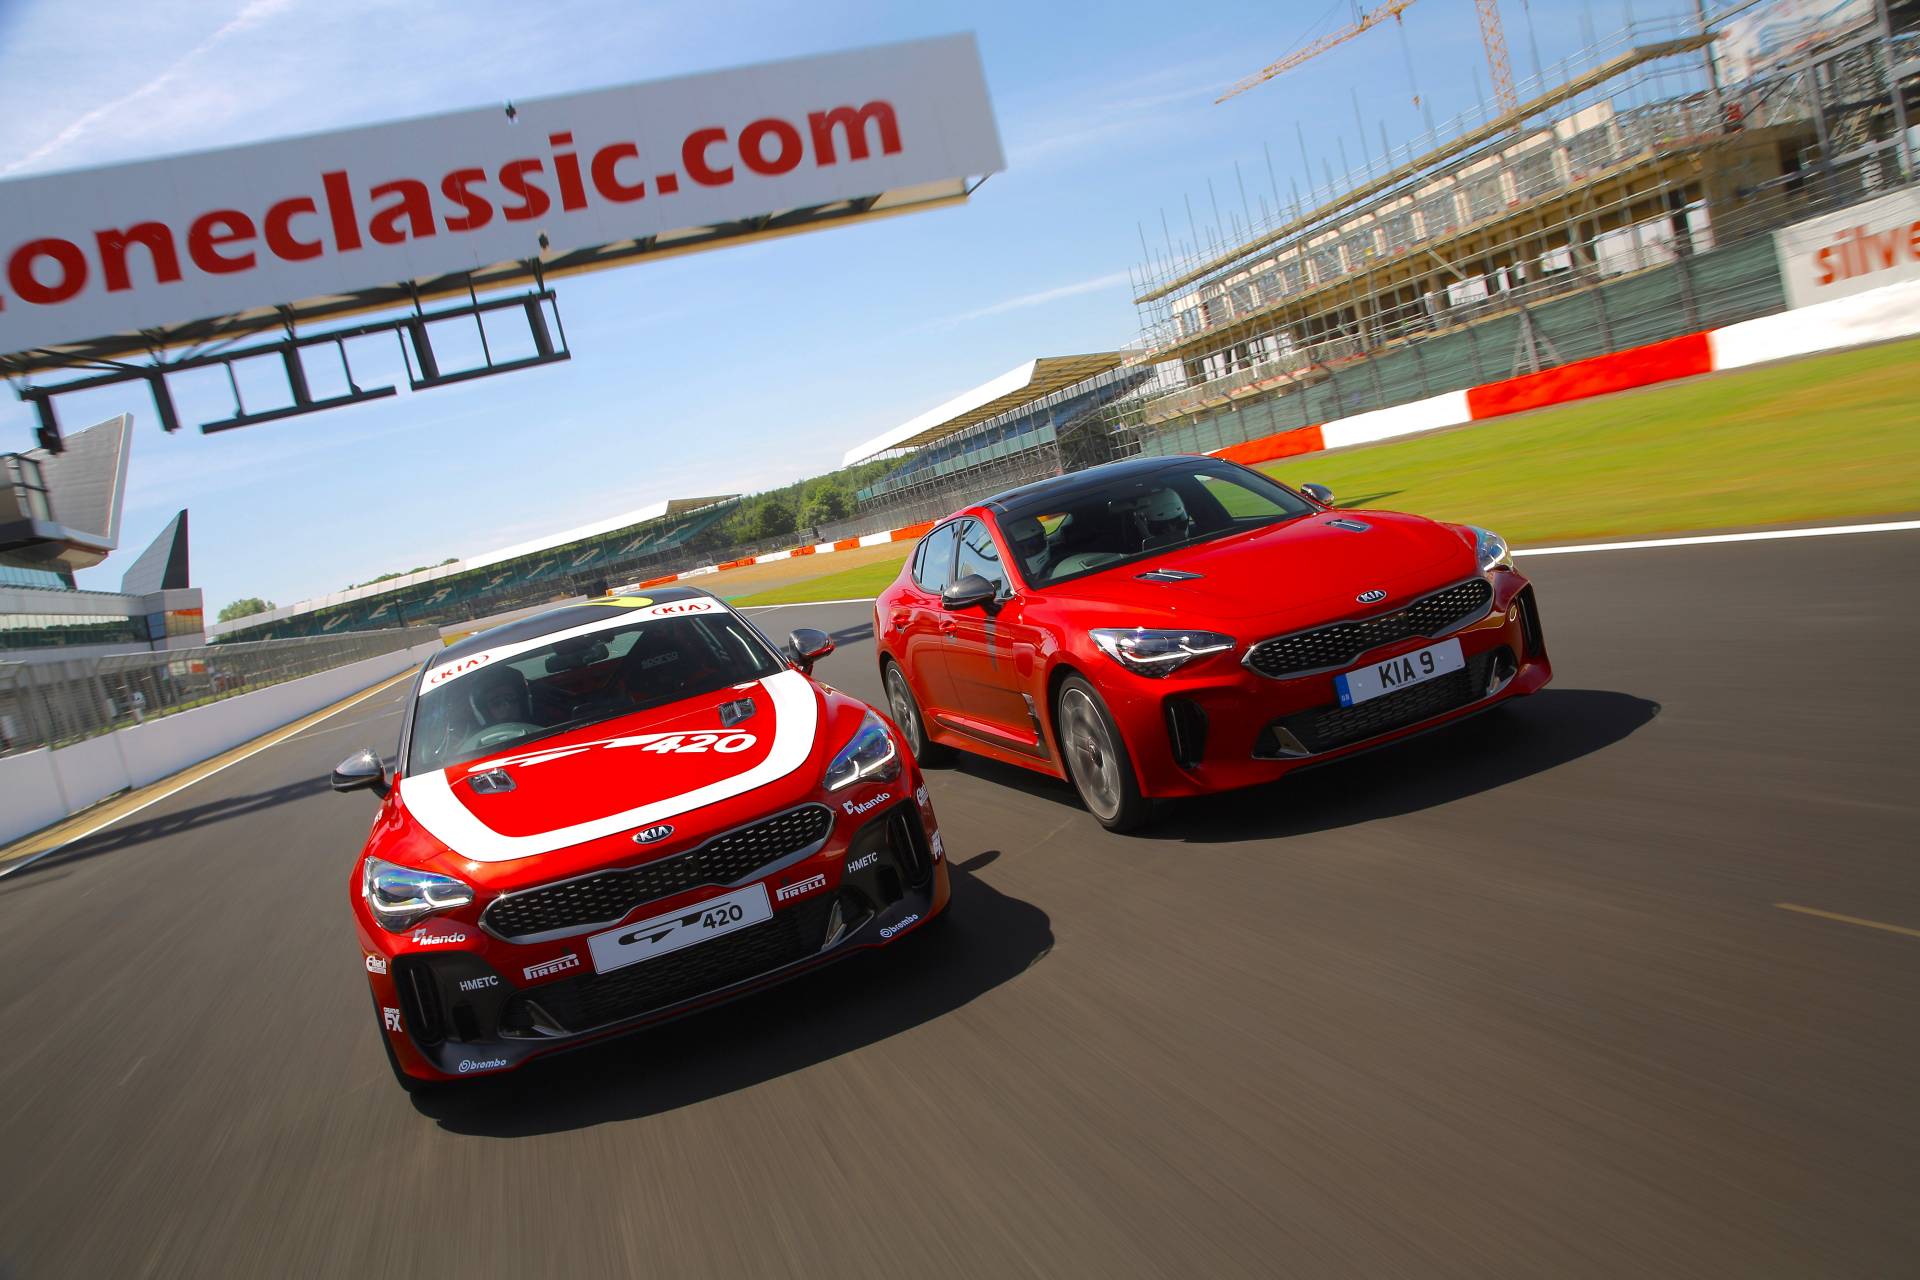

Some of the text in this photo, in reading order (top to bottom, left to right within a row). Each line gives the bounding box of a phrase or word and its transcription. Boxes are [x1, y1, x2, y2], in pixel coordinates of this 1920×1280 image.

[0, 98, 903, 313] oneclassic.com
[1360, 591, 1384, 602] KIA
[661, 604, 702, 614] KIA
[441, 659, 479, 679] KIA
[1378, 657, 1416, 688] KIA
[1419, 651, 1435, 675] 9
[642, 733, 758, 754] 420
[854, 792, 891, 814] Mando
[638, 826, 670, 843] KIA
[848, 852, 878, 873] HMETC
[776, 873, 826, 901] PIRELLI
[702, 904, 744, 929] 420
[888, 914, 919, 933] brembo
[420, 932, 466, 946] Mando
[522, 953, 580, 980] PIRELLI
[459, 975, 499, 991] HMETC
[384, 1013, 404, 1033] FX
[469, 1059, 507, 1071] brembo
